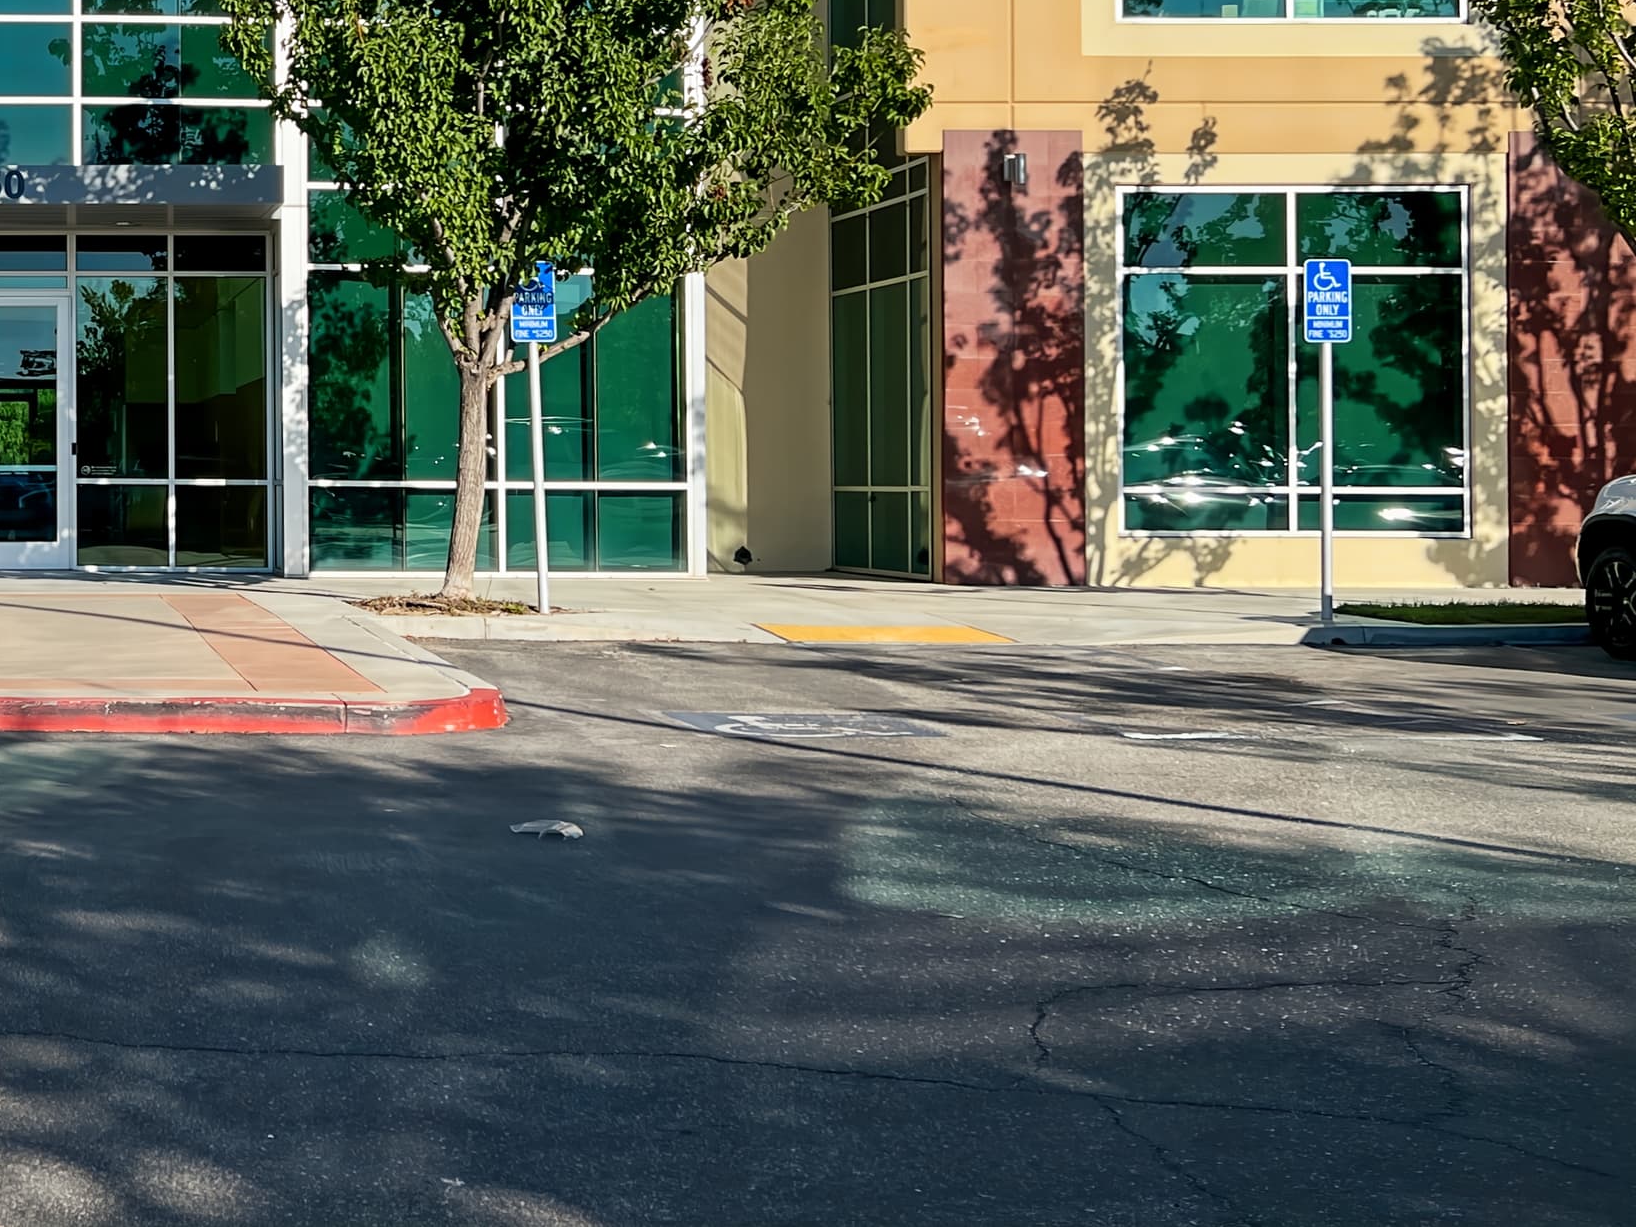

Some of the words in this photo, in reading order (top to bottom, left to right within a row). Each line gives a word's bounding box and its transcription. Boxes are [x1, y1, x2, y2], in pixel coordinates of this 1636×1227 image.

[513, 292, 552, 304] PARKING
[1307, 291, 1348, 303] PARKING
[521, 304, 544, 316] ONLY
[1315, 304, 1339, 316] ONLY
